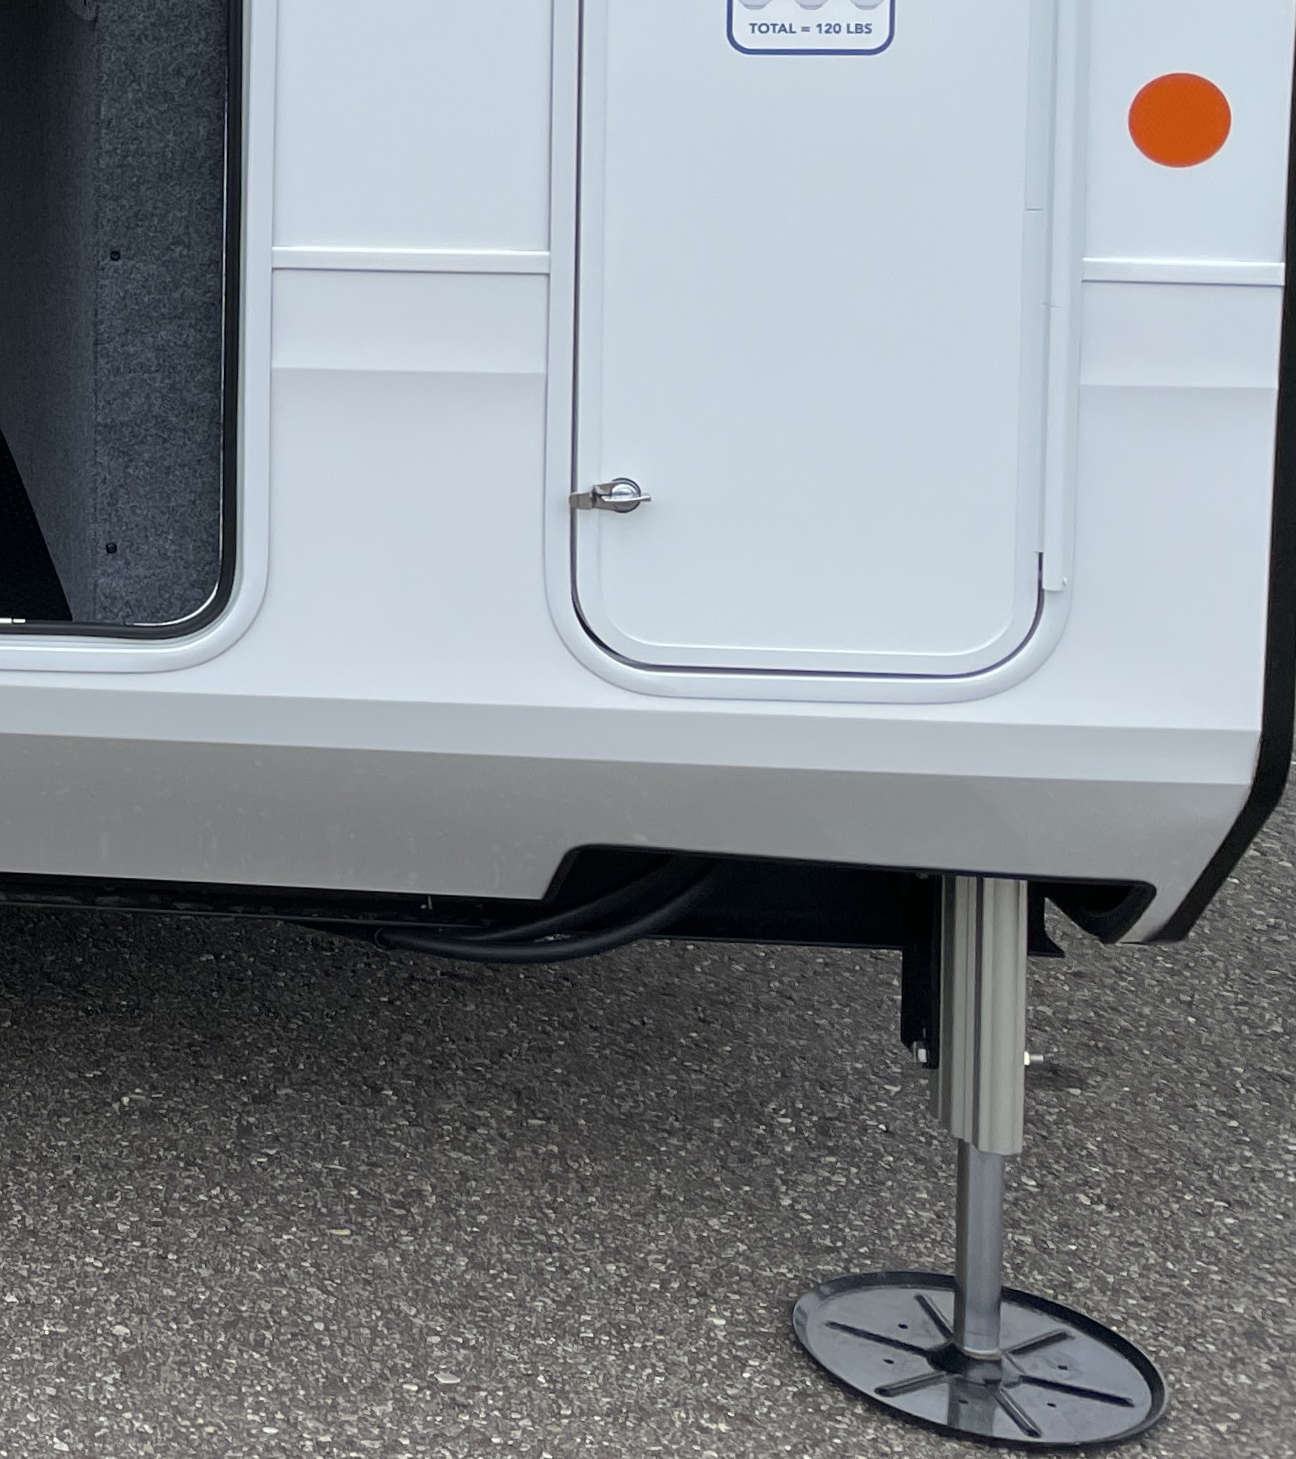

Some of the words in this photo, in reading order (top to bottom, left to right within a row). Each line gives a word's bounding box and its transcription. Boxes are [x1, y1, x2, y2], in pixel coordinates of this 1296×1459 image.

[749, 23, 796, 34] TOTAL
[816, 23, 841, 34] 120
[846, 23, 873, 34] LBS
